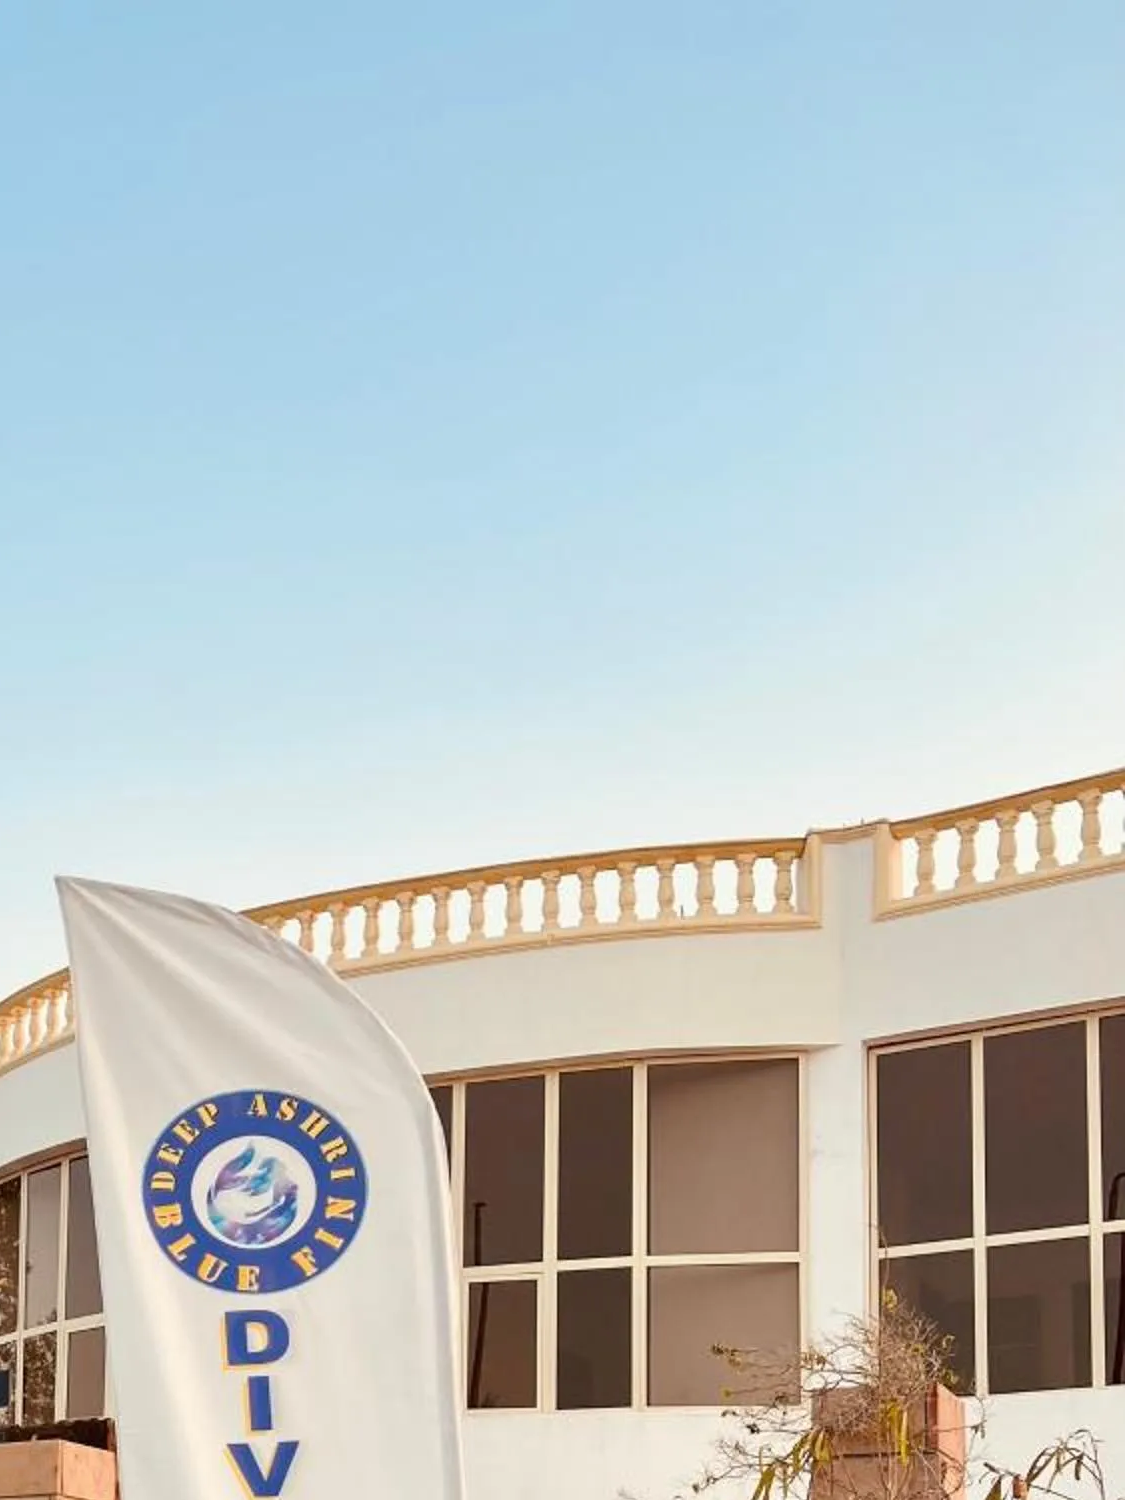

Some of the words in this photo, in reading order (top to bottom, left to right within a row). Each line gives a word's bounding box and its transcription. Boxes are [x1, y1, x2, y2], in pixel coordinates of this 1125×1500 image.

[150, 1103, 220, 1191] DEEP
[247, 1093, 355, 1180] ASHRI
[152, 1203, 261, 1292] BLUE
[291, 1196, 357, 1276] FIN
